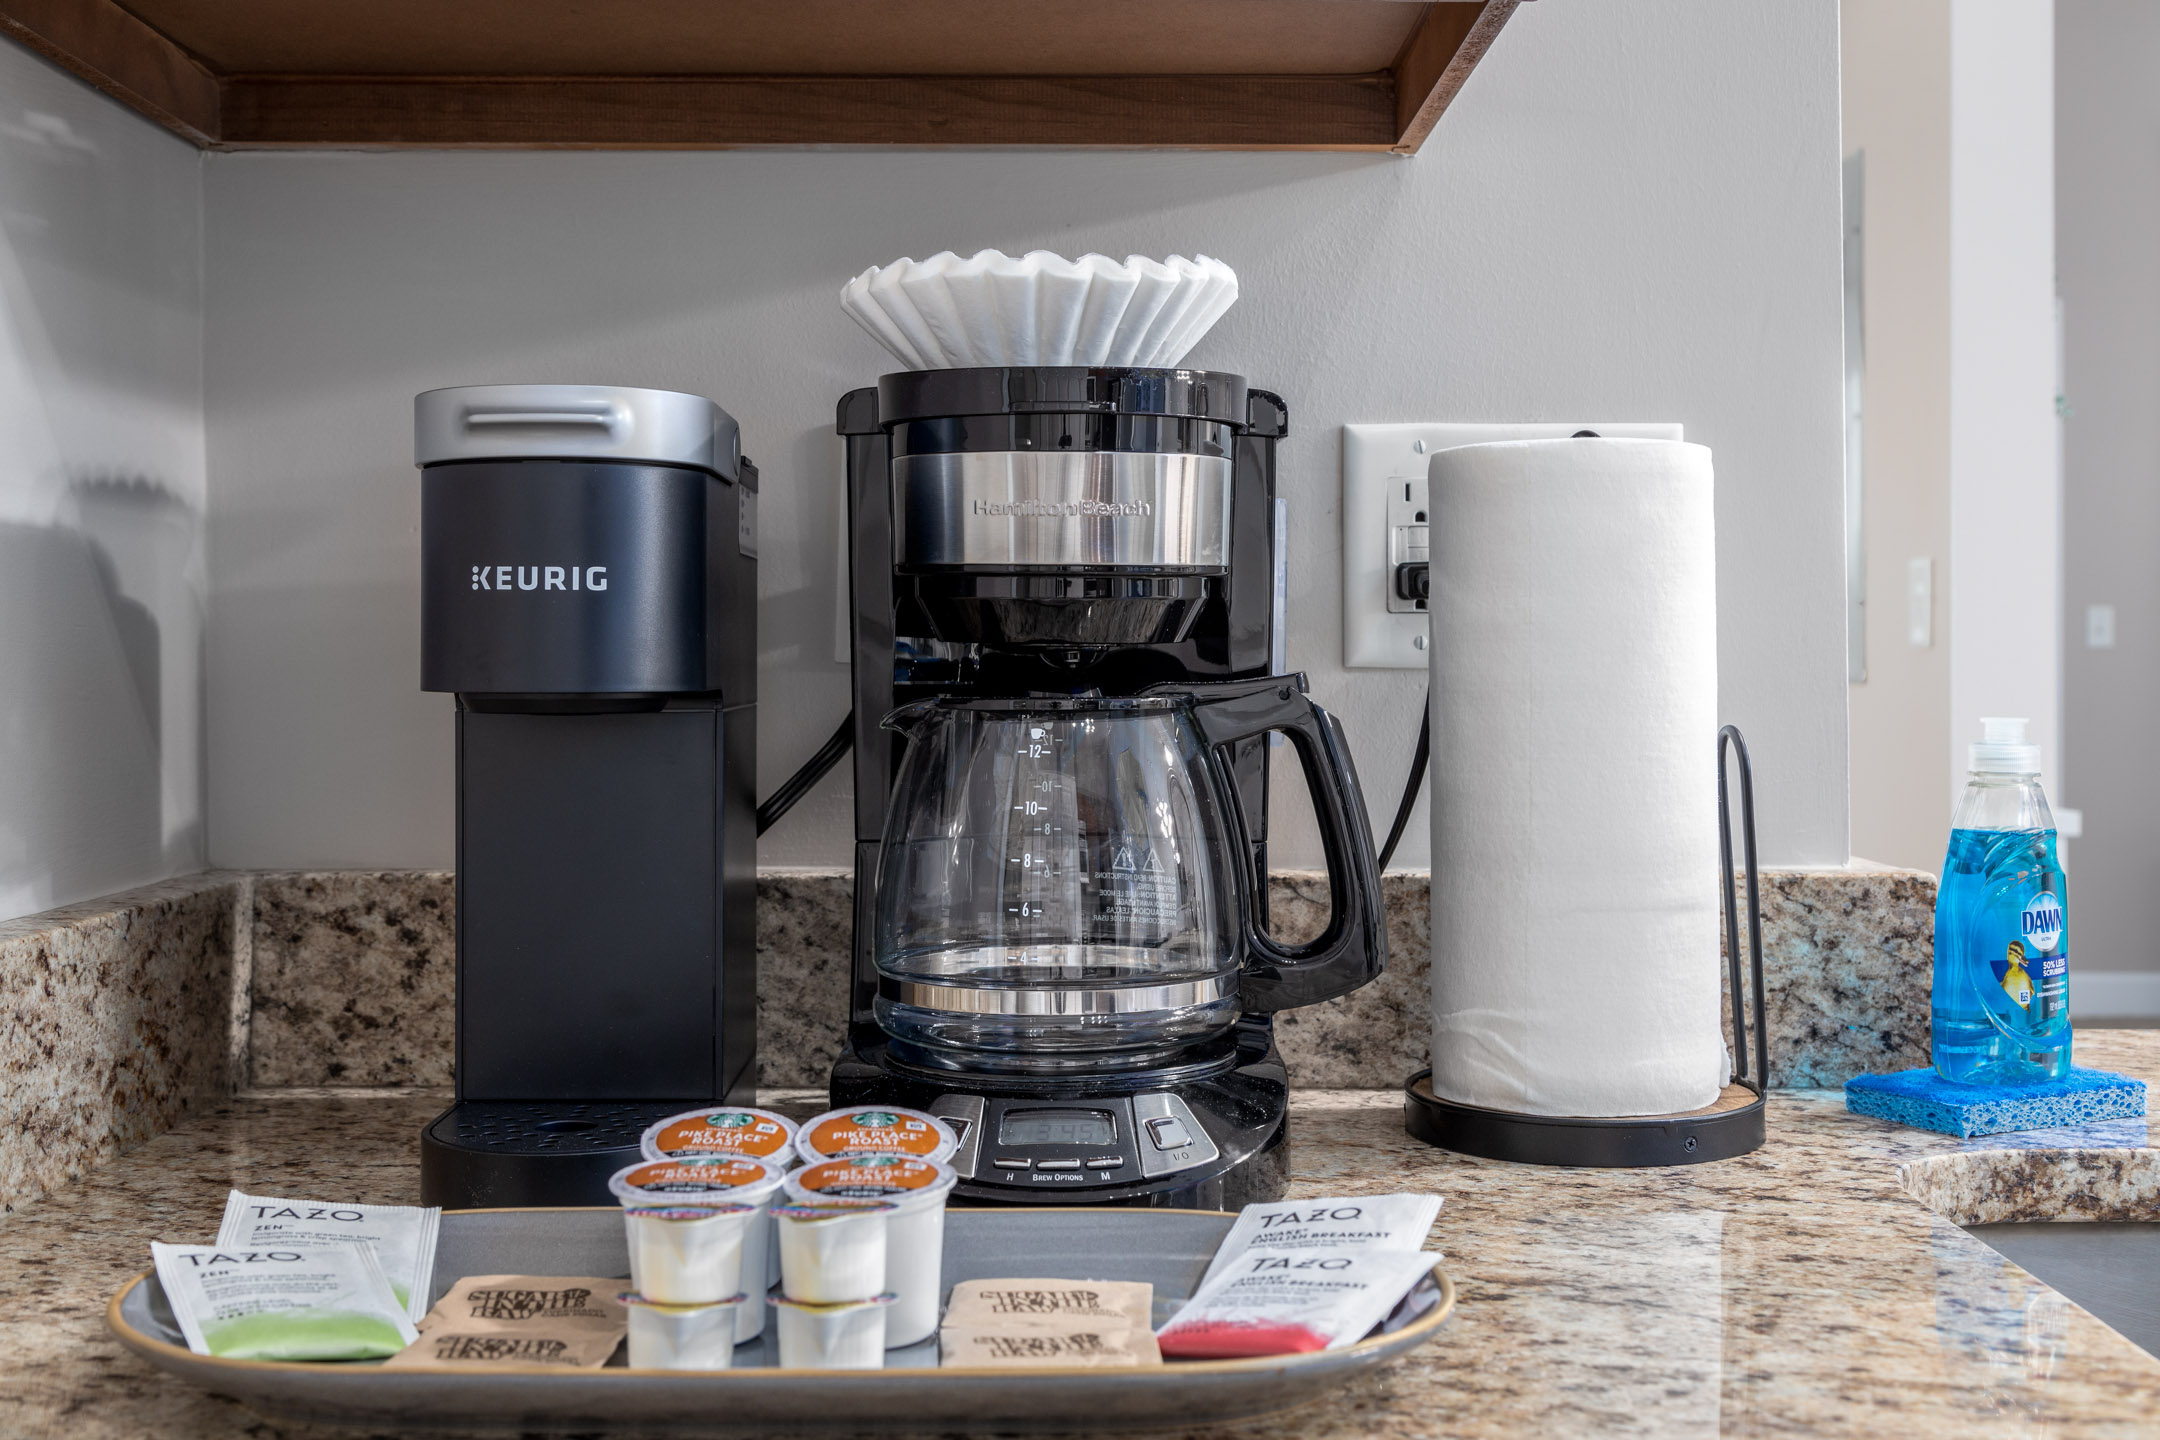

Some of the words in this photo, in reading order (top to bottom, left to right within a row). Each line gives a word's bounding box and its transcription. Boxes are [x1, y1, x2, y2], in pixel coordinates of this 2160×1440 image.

[973, 499, 1078, 516] Hamilton
[1082, 499, 1150, 517] Beach
[472, 566, 608, 591] KEURIG
[1029, 744, 1042, 758] 12
[1025, 801, 1038, 815] 10
[1024, 854, 1031, 868] 8
[1022, 902, 1029, 916] 6
[2022, 908, 2063, 935] DAWN
[1020, 952, 1027, 965] 4
[2043, 960, 2056, 970] 50%
[2056, 958, 2065, 968] LESS
[678, 1130, 711, 1139] PIKE
[716, 1131, 765, 1143] PLACE
[692, 1136, 740, 1146] ROAST
[832, 1131, 866, 1140] PIKE
[871, 1132, 918, 1140] PLACE
[850, 1137, 898, 1145] ROAST
[1006, 1173, 1014, 1181] H
[1101, 1172, 1110, 1180] M
[251, 1206, 364, 1222] TAZO
[1261, 1207, 1362, 1228] TAZO
[254, 1224, 283, 1232] ZEN
[178, 1251, 306, 1267] TAZO
[1252, 1258, 1352, 1272] TAZO
